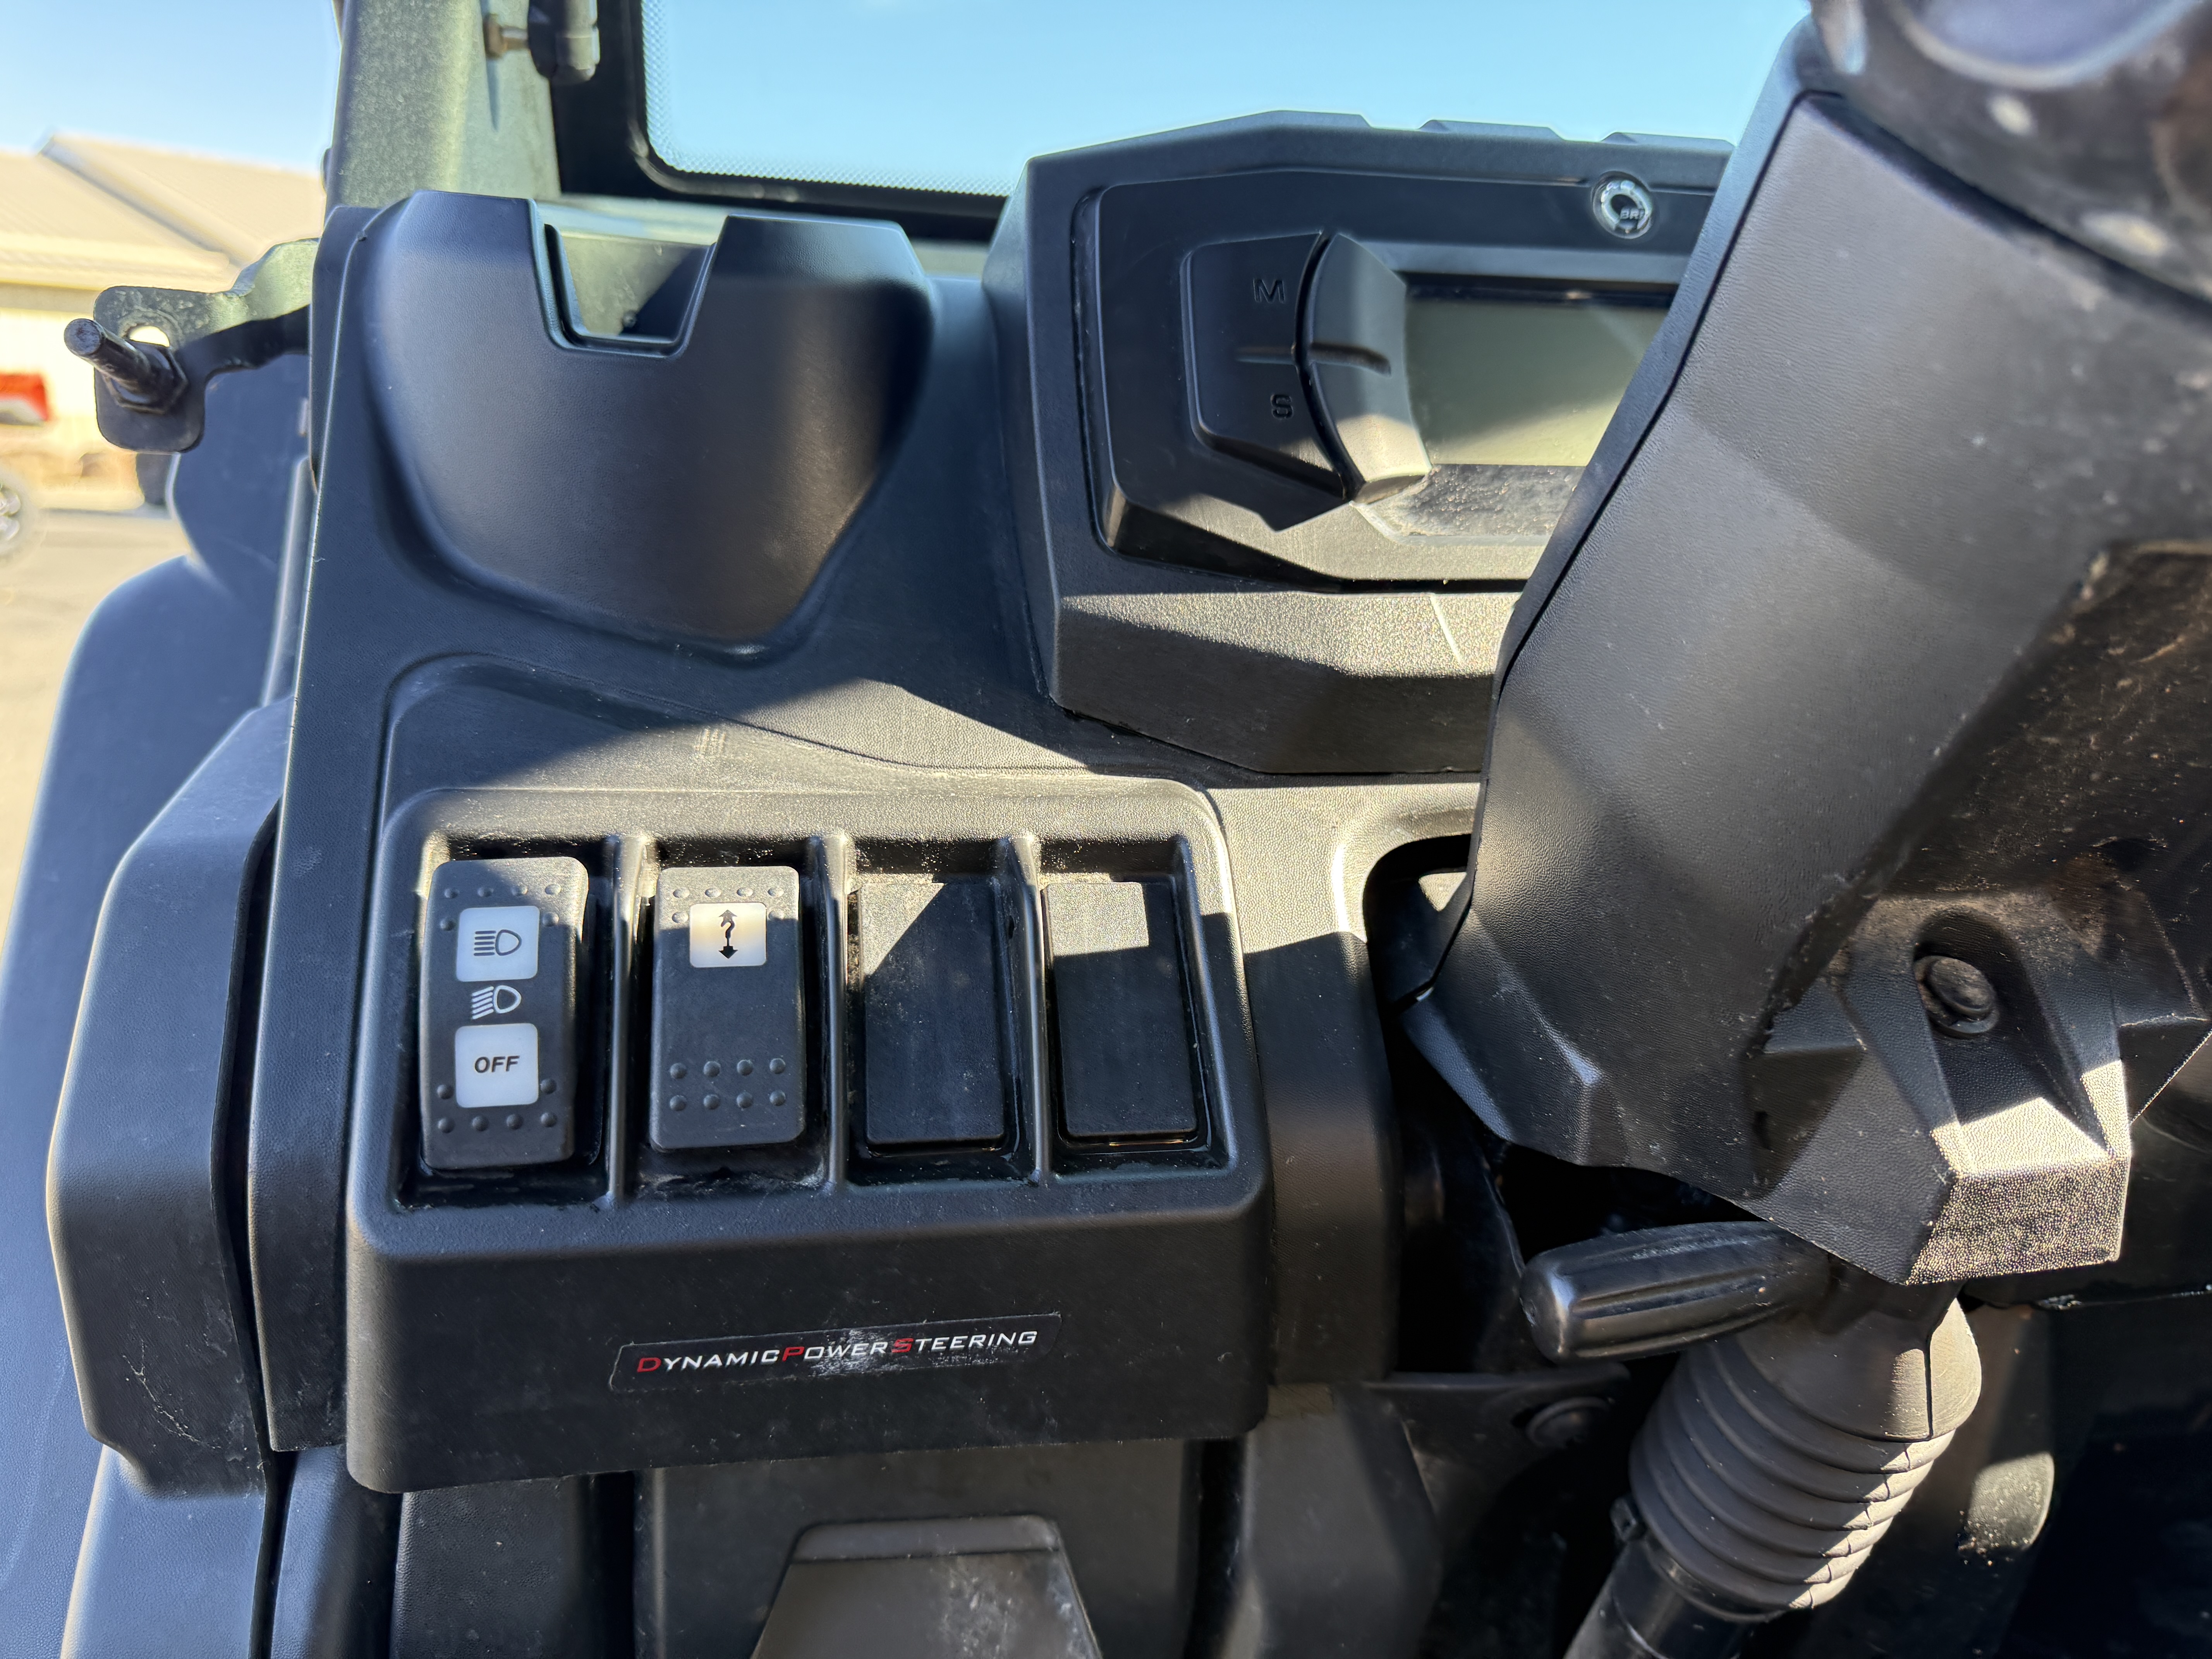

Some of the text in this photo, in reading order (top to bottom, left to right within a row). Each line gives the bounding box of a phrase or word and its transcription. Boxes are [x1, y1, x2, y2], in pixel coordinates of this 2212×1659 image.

[1253, 278, 1286, 304] M
[1270, 393, 1294, 419] S
[474, 1055, 520, 1074] OFF
